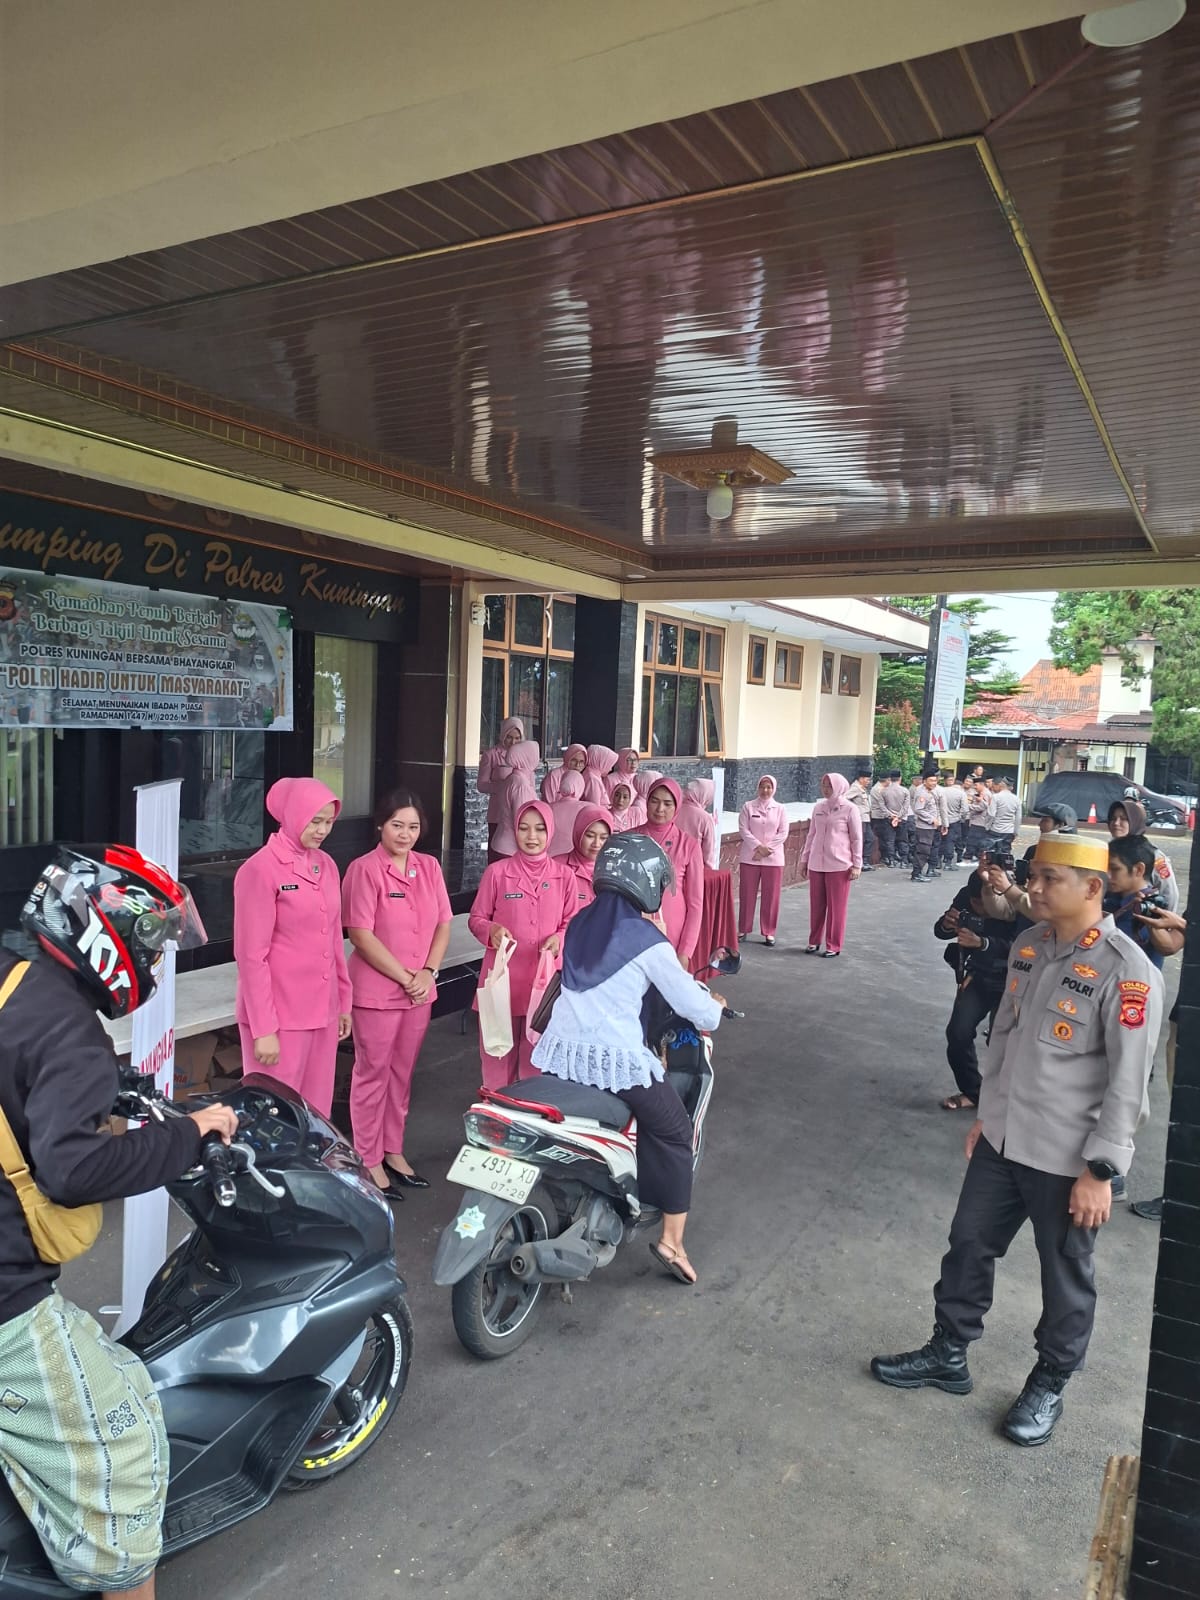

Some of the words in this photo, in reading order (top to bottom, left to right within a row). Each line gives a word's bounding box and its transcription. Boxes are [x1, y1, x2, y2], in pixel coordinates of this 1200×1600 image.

[144, 532, 191, 579] Di
[204, 541, 286, 595] Polres
[300, 562, 405, 620] Kuningan
[44, 590, 125, 616] Ramadhan
[126, 600, 171, 621] Penuh
[173, 607, 219, 628] Berkah
[32, 613, 92, 639] Berbagi
[96, 619, 134, 642] Takjil
[139, 624, 181, 647] Untuk
[181, 630, 227, 648] Sesama
[21, 645, 63, 658] POLRES
[66, 649, 123, 662] KUNINGAN
[126, 653, 171, 666] BERSAMA
[173, 657, 235, 671] BHAYANGKARI
[60, 668, 105, 690] HADIR
[110, 672, 156, 692] UNTUK
[62, 699, 96, 708] SELAMAT
[99, 700, 149, 710] MENUNAIKAN
[151, 702, 179, 710] IBADAH
[181, 703, 203, 711] PUASA
[80, 711, 124, 720] RAMADHAN
[127, 712, 146, 720] 1447
[160, 712, 178, 721] 2026
[181, 713, 187, 721] M
[77, 906, 131, 991] KYT
[1011, 960, 1033, 974] AKBAR
[1061, 977, 1095, 998] POLRI
[458, 1148, 472, 1165] E
[481, 1156, 513, 1176] 4931
[518, 1169, 537, 1186] XD
